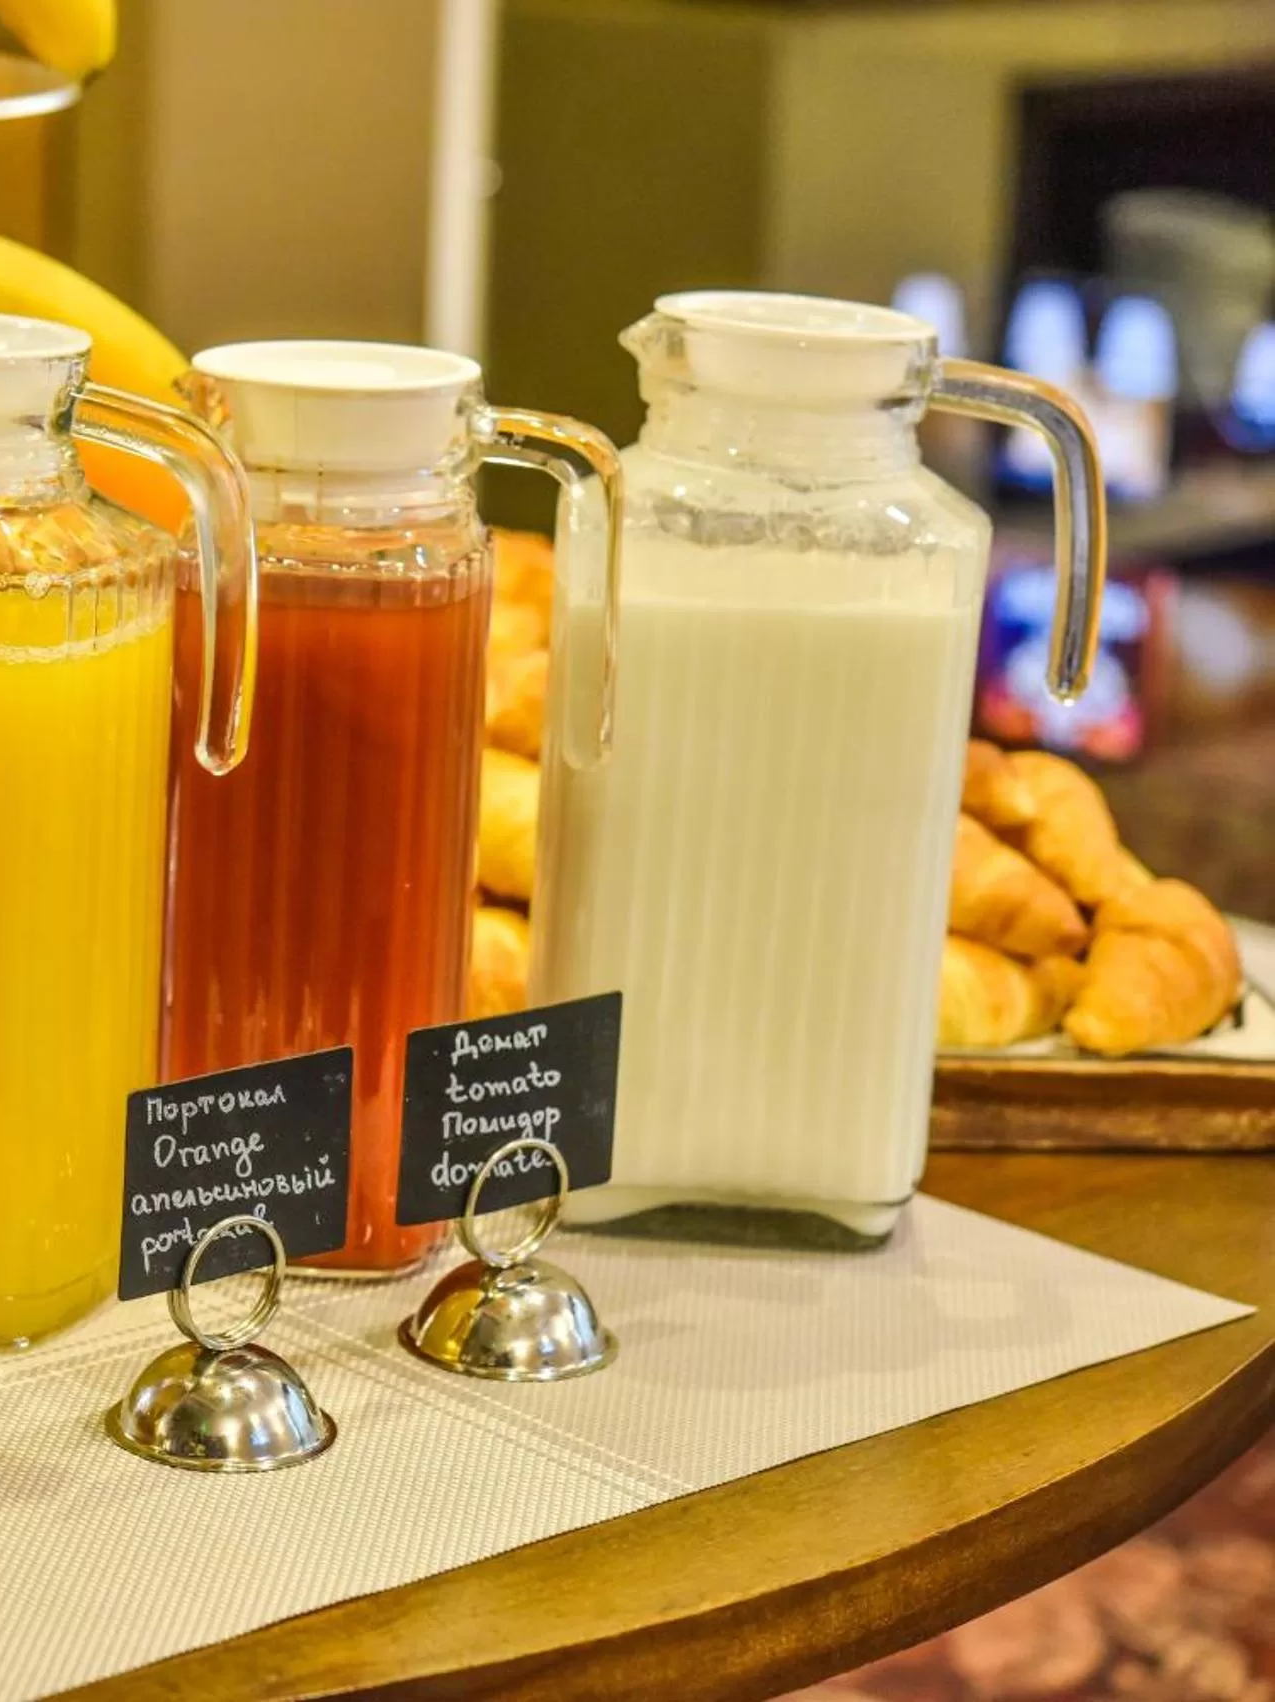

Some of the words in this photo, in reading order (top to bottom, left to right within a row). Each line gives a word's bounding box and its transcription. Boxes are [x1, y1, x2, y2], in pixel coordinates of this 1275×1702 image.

[450, 1023, 548, 1066] Домат
[445, 1061, 562, 1104] tomato
[146, 1084, 287, 1135] Портокал
[442, 1106, 561, 1143] Помидор
[153, 1132, 265, 1178] Orange
